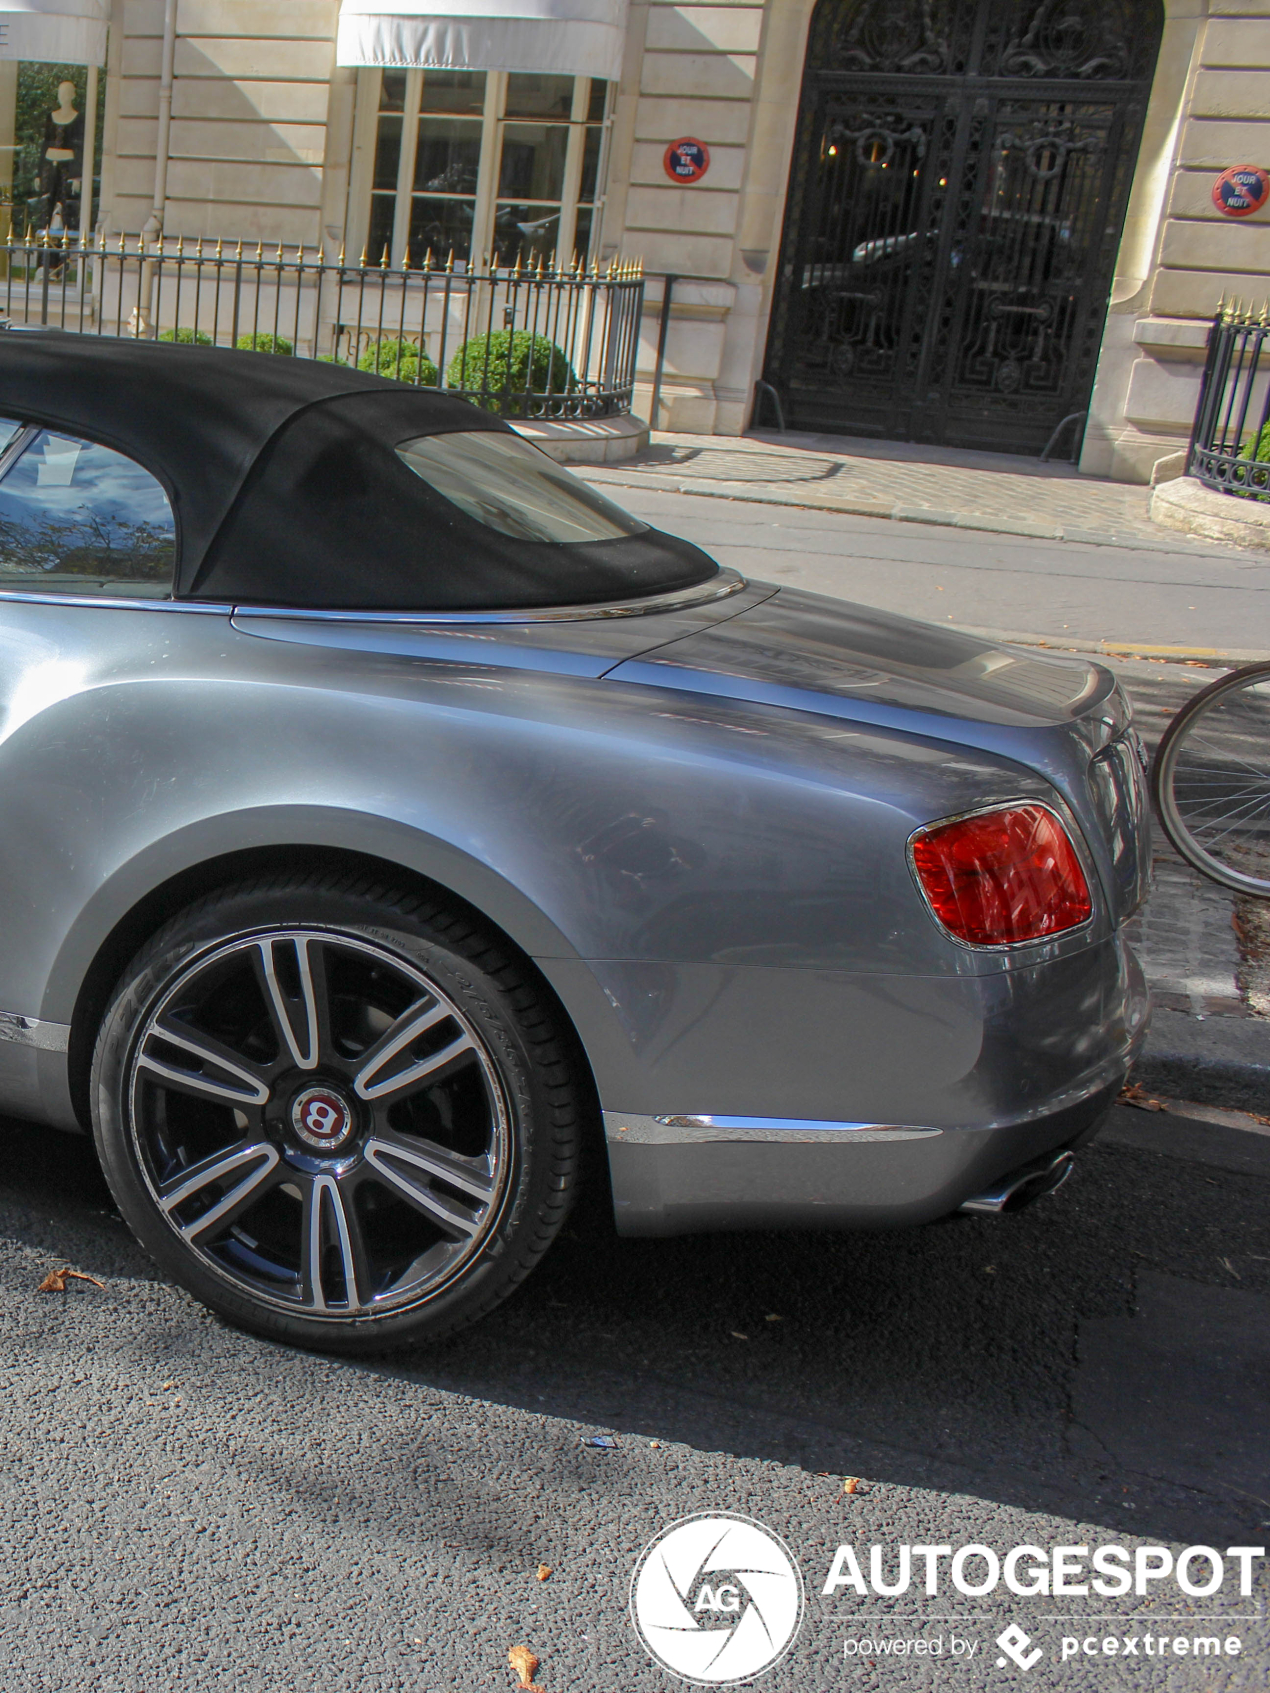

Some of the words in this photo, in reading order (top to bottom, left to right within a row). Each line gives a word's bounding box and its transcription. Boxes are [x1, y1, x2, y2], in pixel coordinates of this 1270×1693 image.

[676, 145, 698, 154] JOUR
[680, 156, 691, 165] ET
[675, 165, 694, 175] NUIT
[1231, 174, 1256, 184] JOUR
[1234, 186, 1248, 195] ET
[1226, 197, 1249, 208] NUIT
[306, 1101, 339, 1134] B
